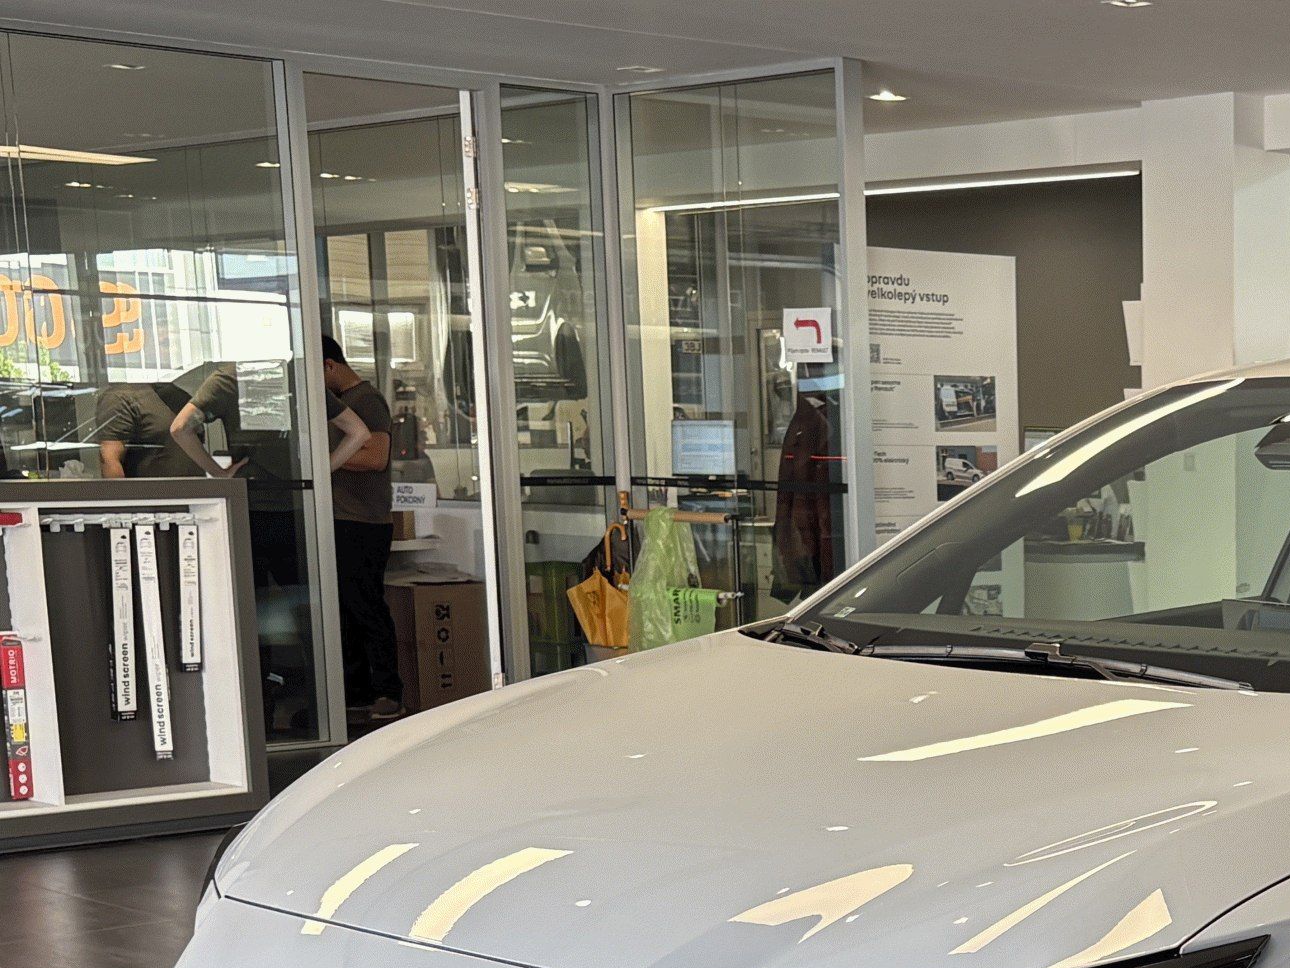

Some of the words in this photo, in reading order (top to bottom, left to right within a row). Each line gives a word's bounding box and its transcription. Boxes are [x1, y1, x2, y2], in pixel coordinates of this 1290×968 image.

[918, 292, 949, 306] vstup
[10, 649, 18, 684] MOTRIO
[121, 642, 129, 679] screen
[122, 681, 131, 706] wind
[155, 684, 164, 715] screen
[159, 716, 167, 746] wind
